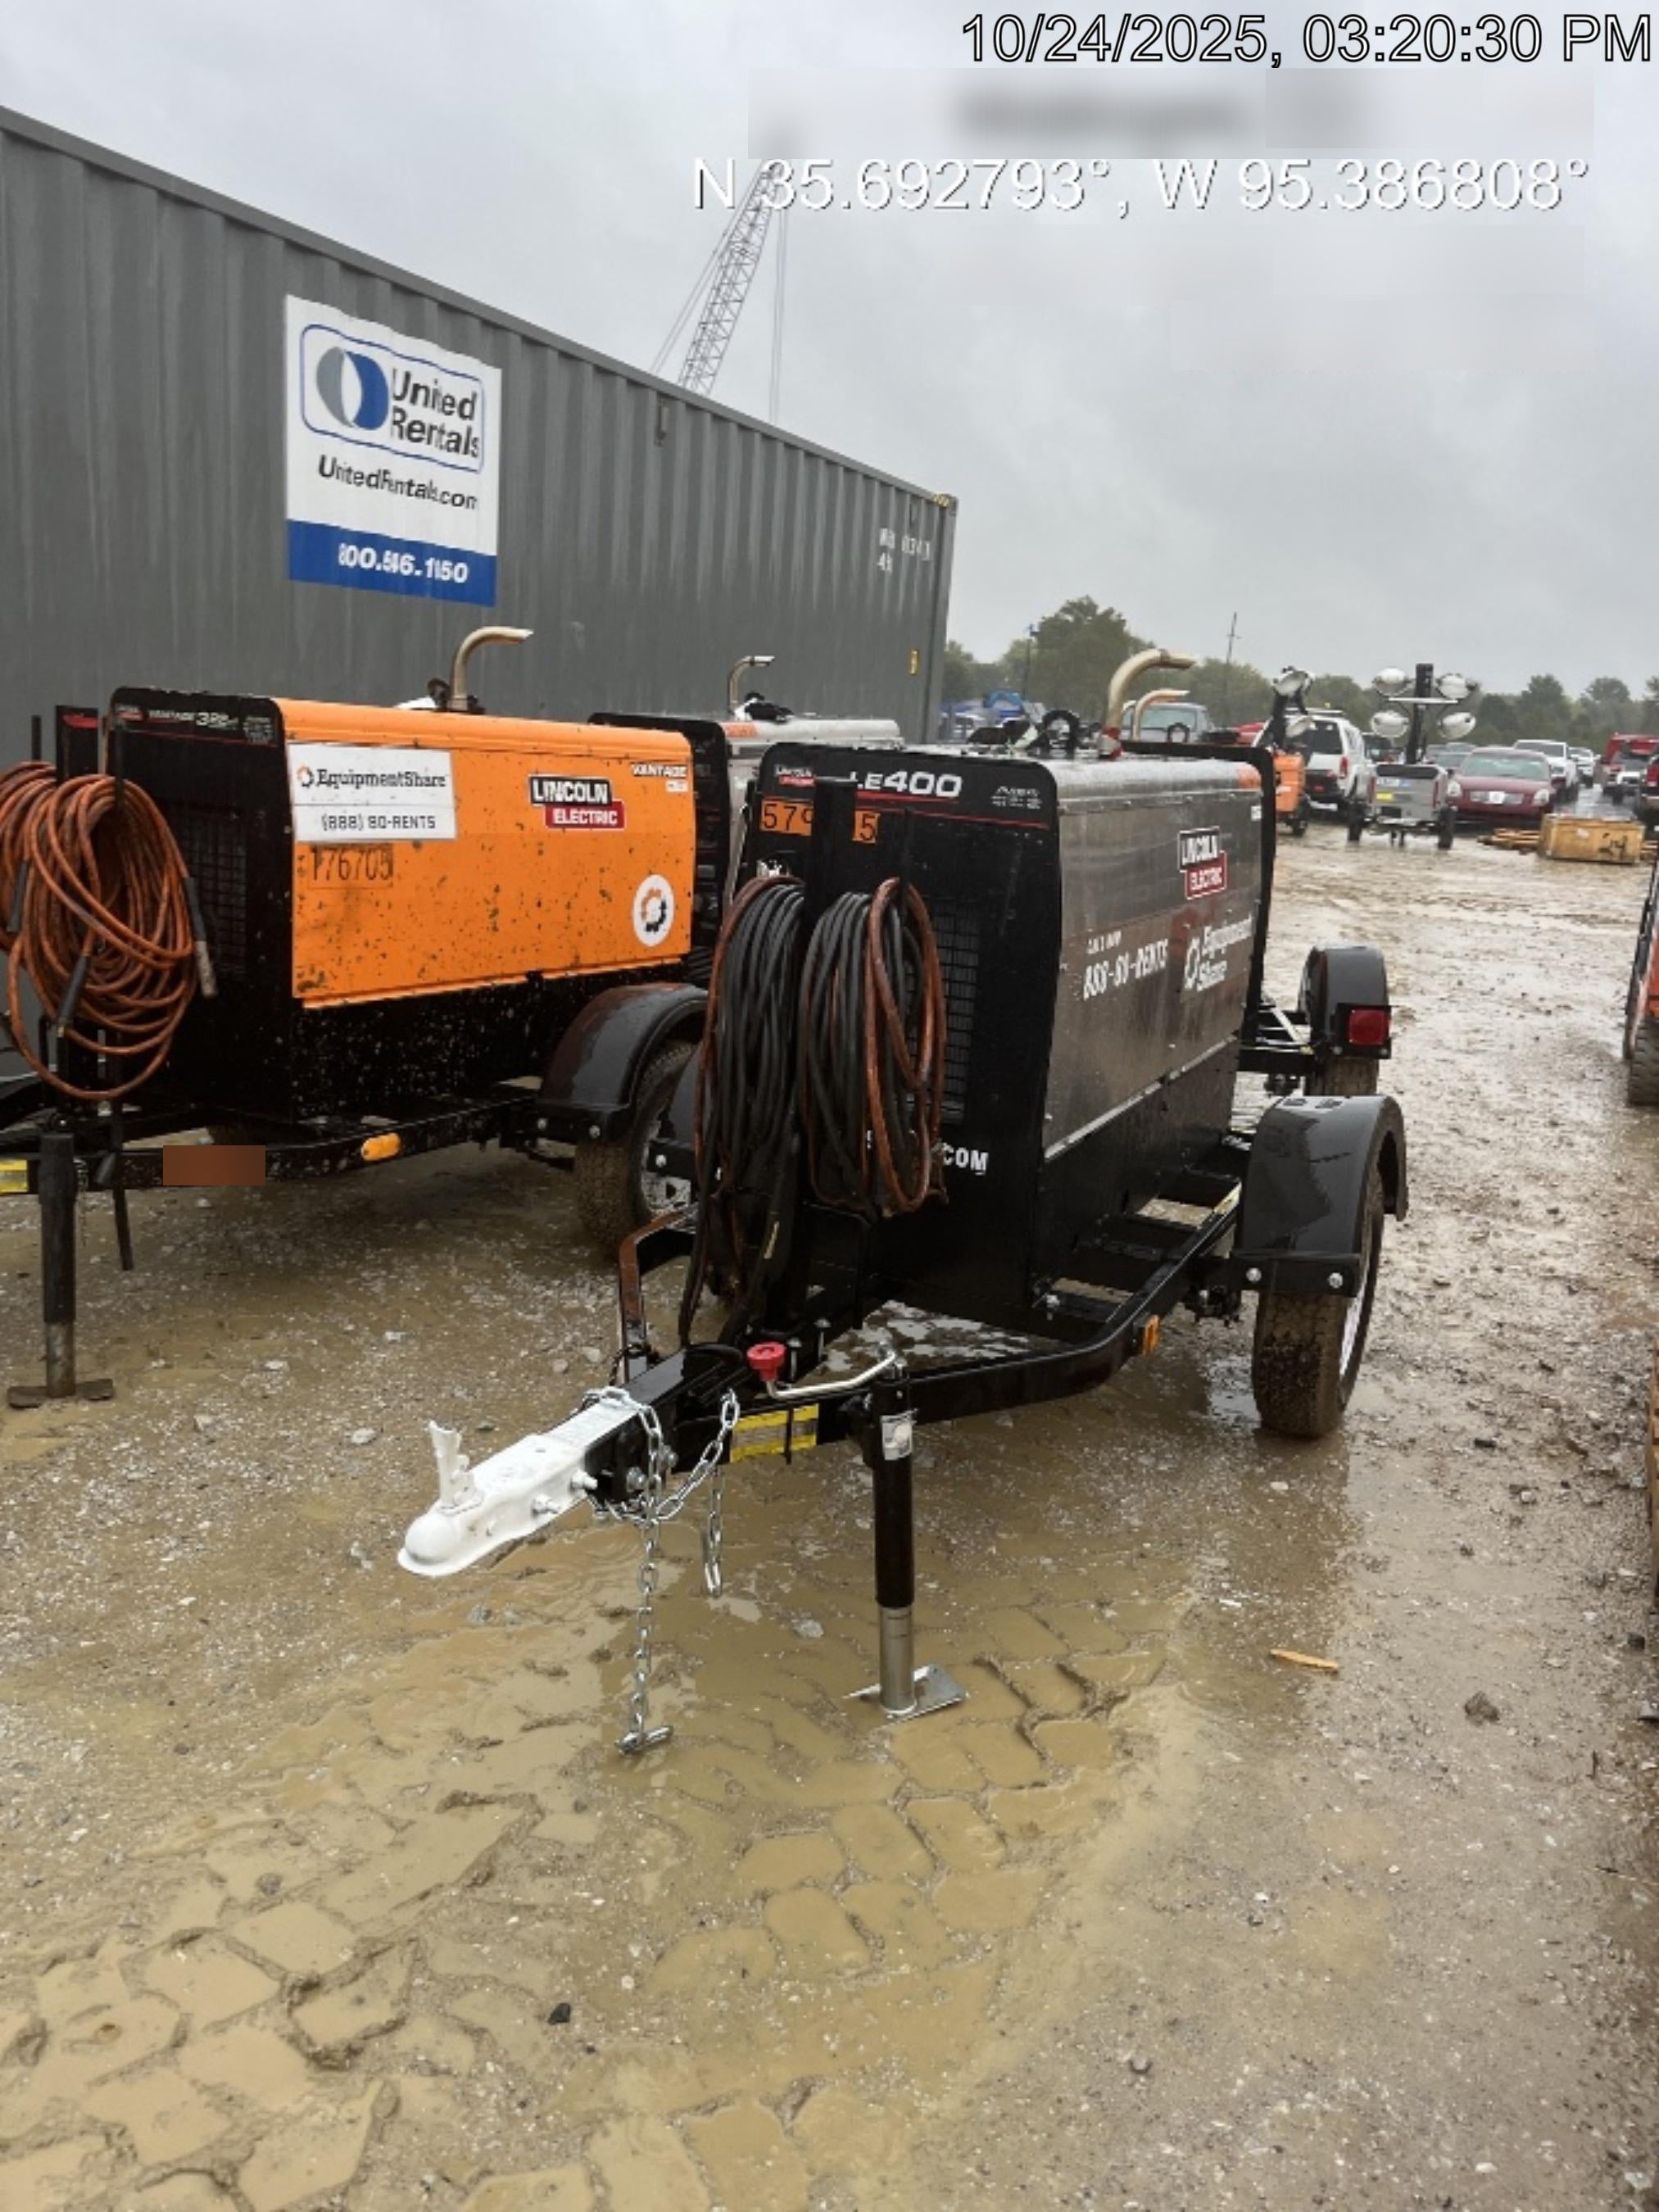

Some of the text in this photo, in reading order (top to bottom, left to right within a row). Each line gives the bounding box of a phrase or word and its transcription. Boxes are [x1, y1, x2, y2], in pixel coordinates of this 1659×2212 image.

[392, 368, 477, 421] United
[391, 406, 479, 458] Rentals
[533, 779, 608, 804] LINCOLN
[321, 813, 364, 831] (888)
[552, 808, 618, 826] ELECTRIC
